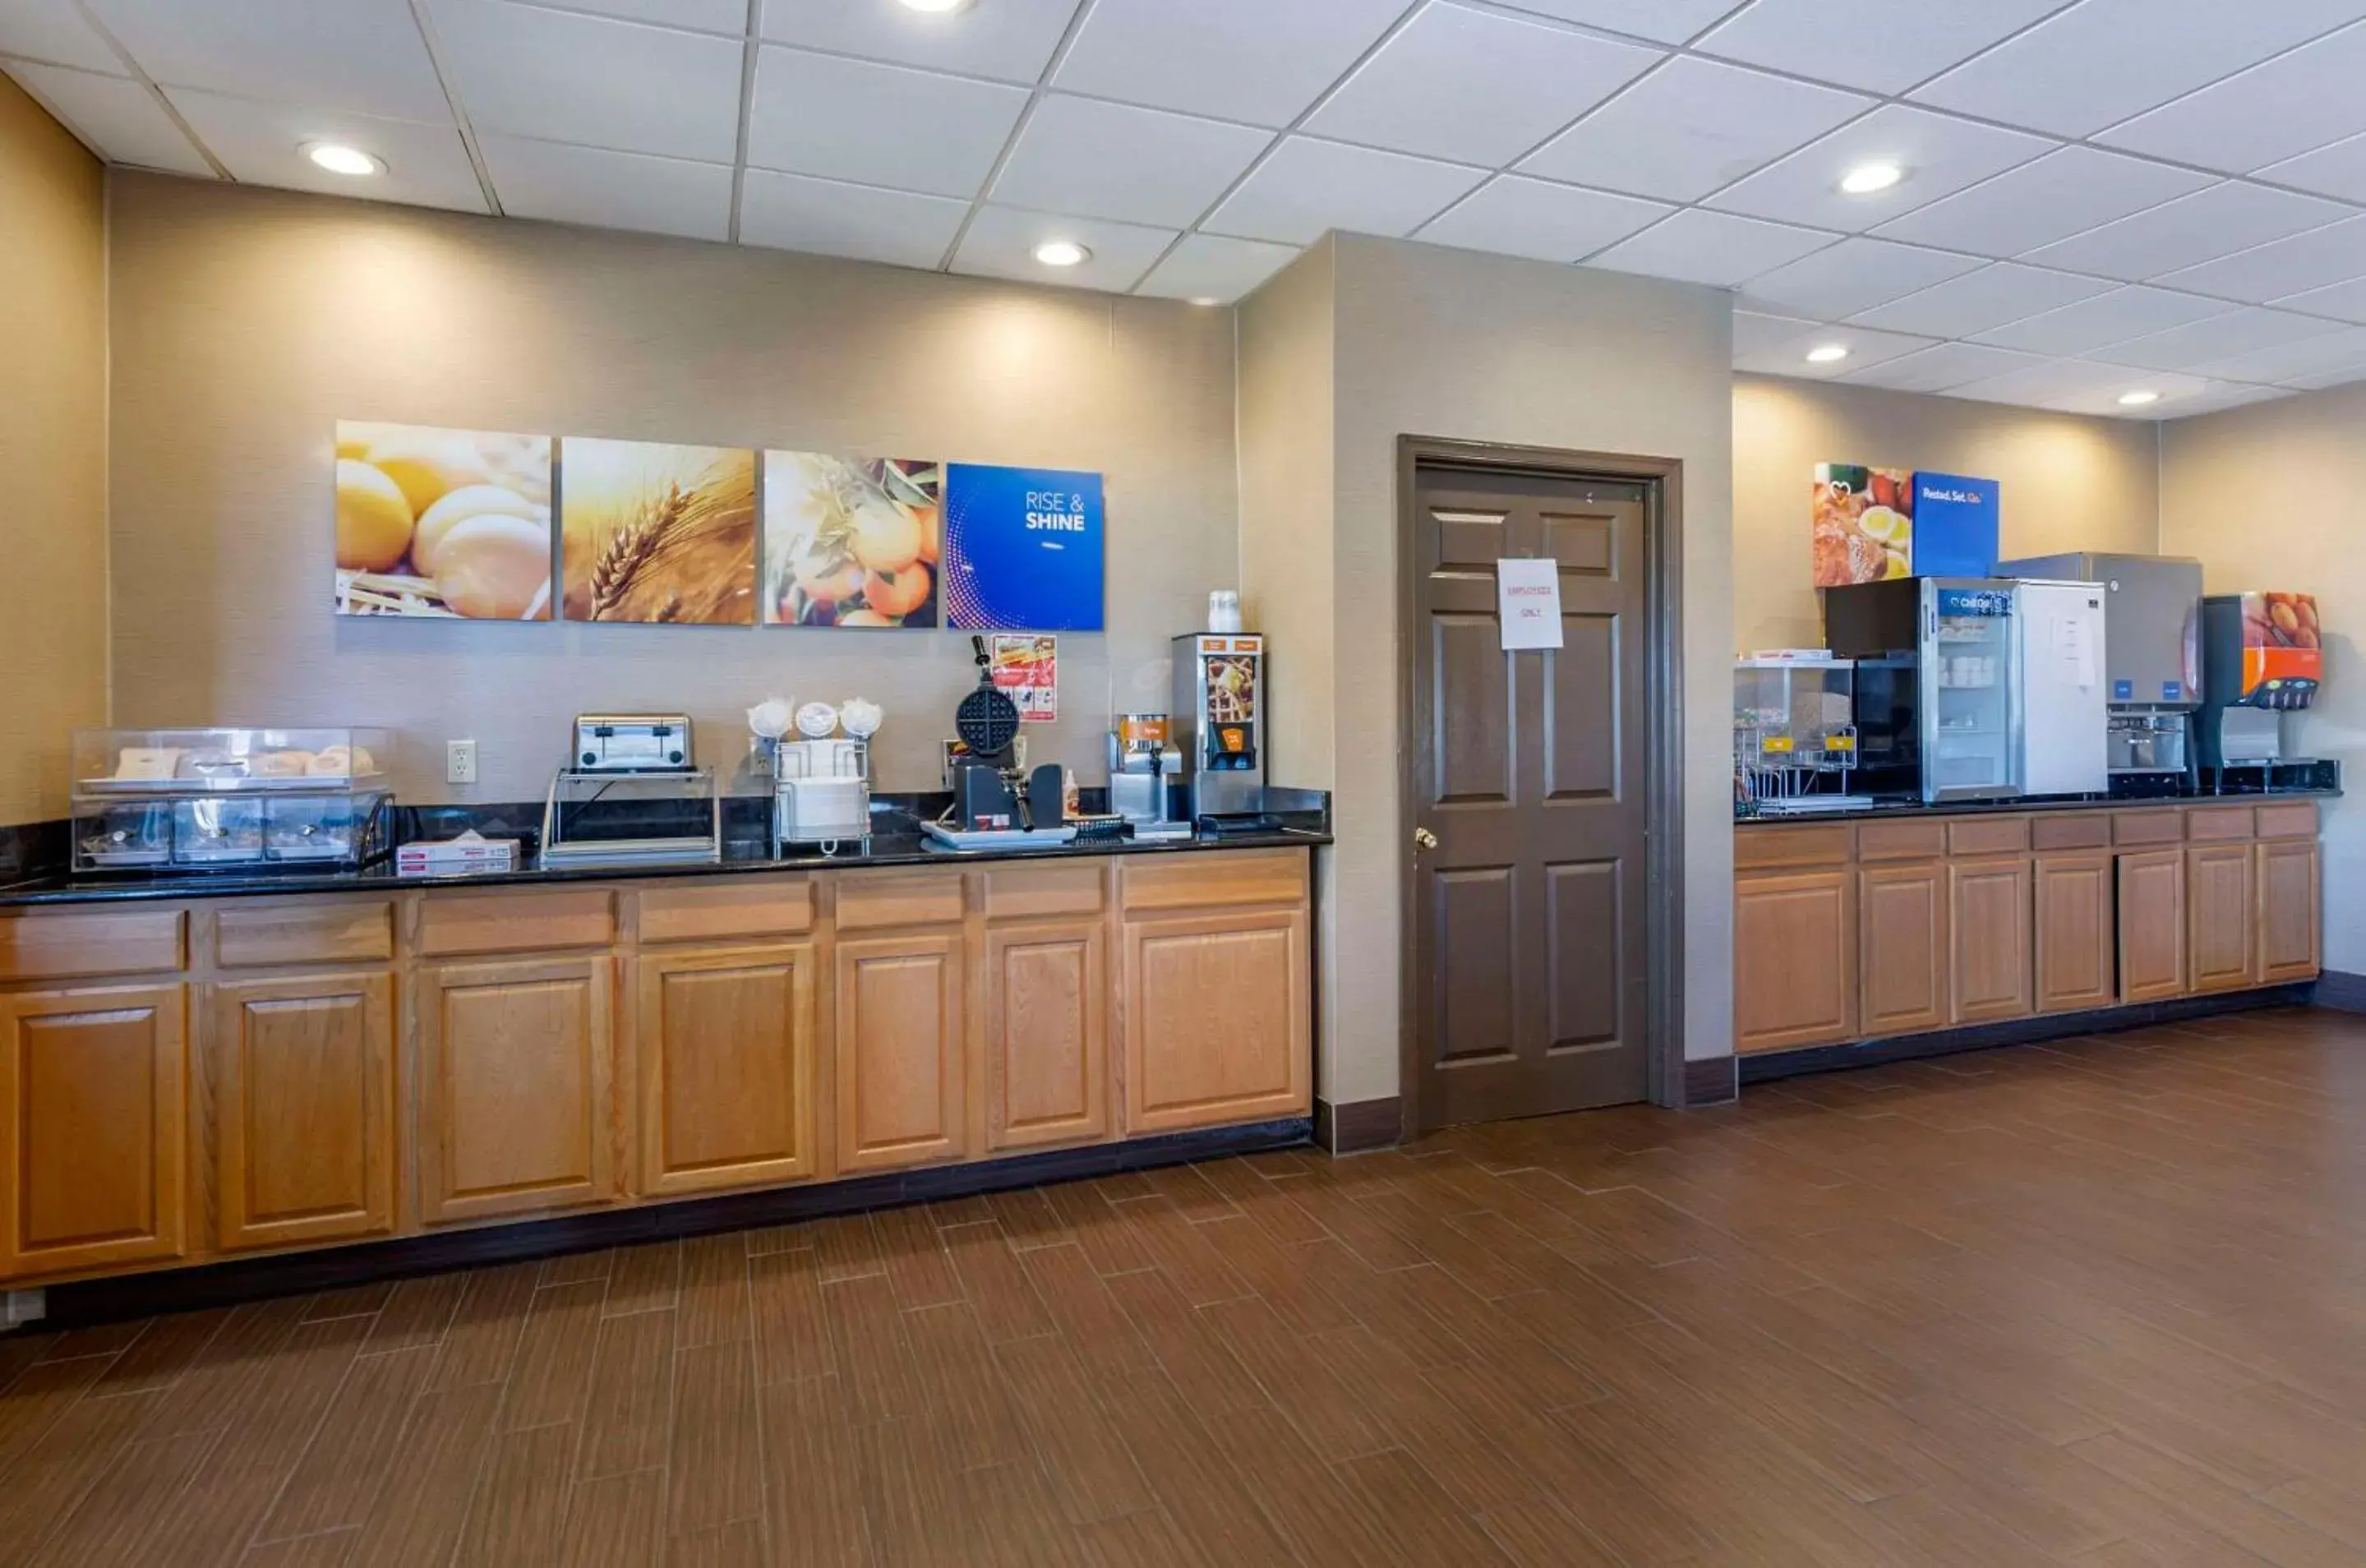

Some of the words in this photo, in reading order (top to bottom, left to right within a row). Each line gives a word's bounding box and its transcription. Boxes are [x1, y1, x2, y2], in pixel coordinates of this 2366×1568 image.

[1026, 491, 1065, 512] RISE
[1070, 493, 1084, 513] &
[1026, 512, 1085, 531] SHINE
